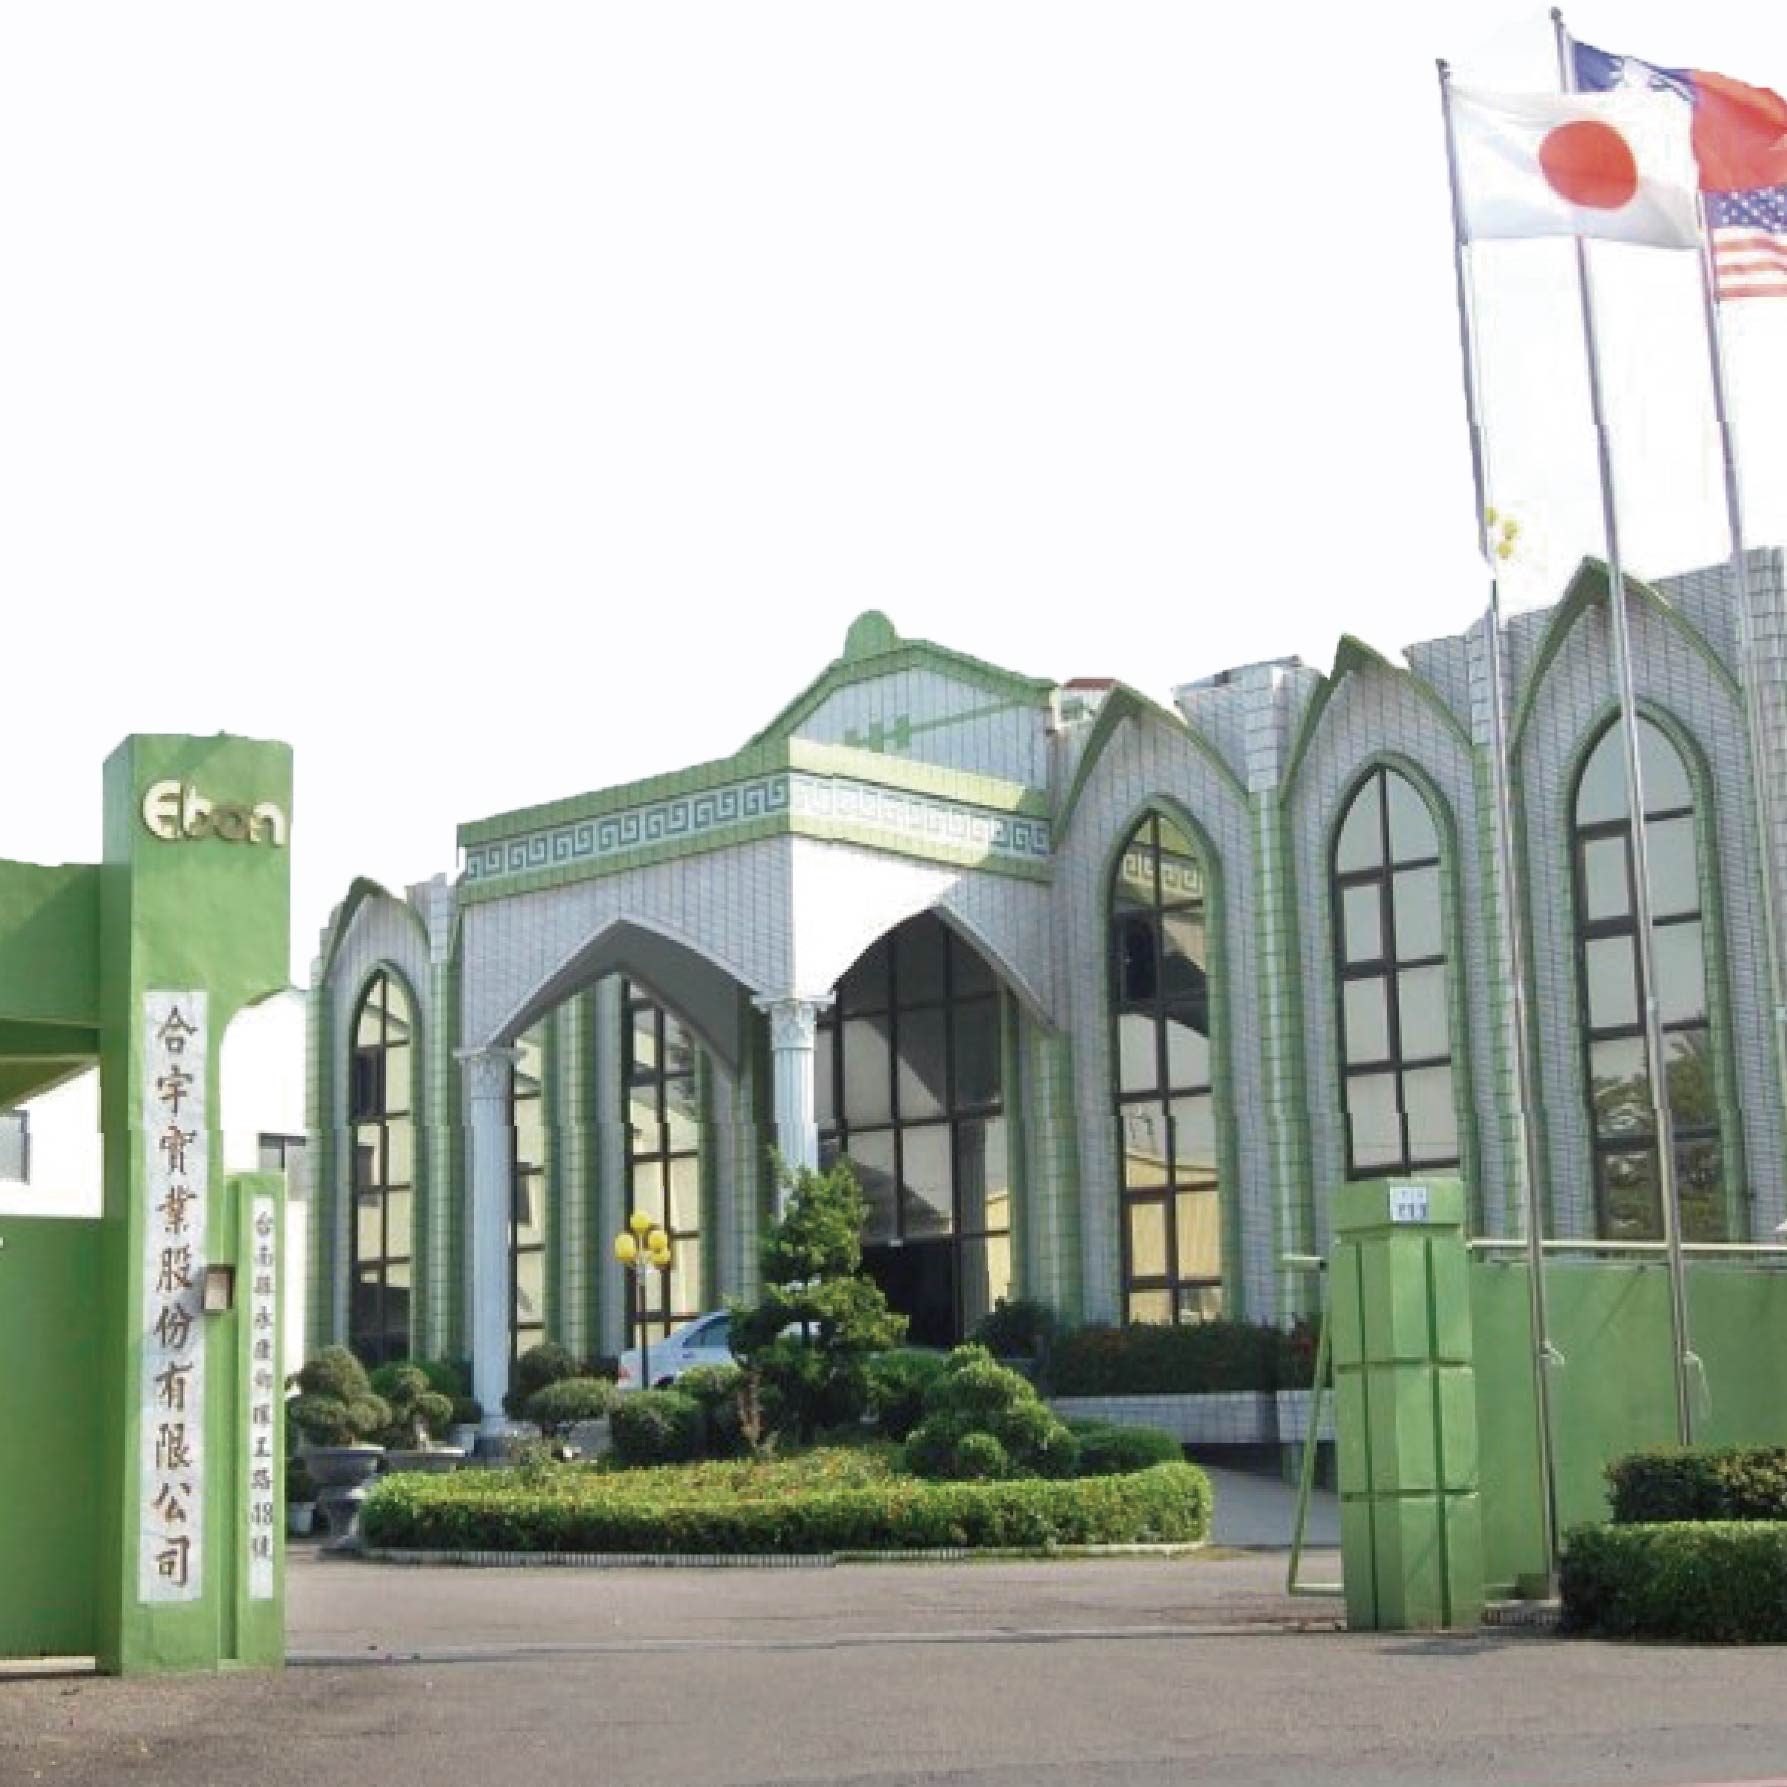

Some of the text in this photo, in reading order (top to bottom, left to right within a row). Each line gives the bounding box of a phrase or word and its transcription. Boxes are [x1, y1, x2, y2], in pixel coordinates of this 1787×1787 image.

[153, 1004, 198, 1588] 合宇實業股份有限公司
